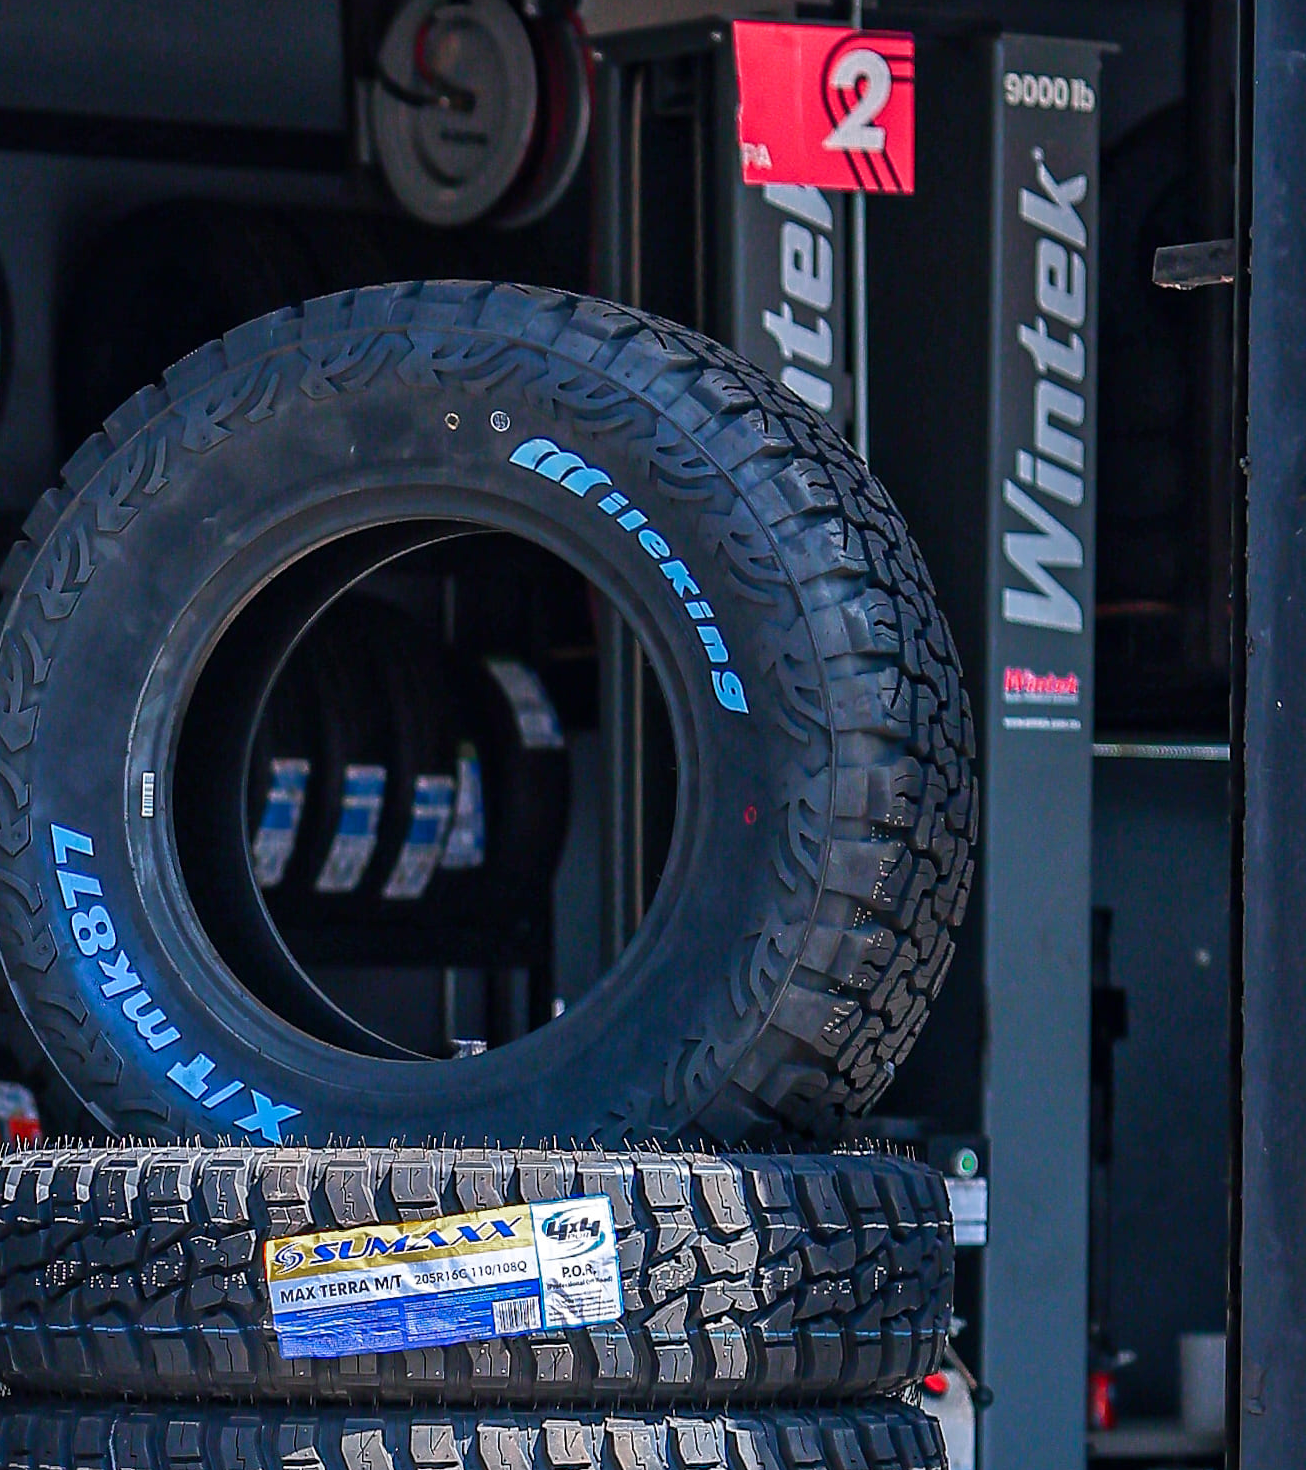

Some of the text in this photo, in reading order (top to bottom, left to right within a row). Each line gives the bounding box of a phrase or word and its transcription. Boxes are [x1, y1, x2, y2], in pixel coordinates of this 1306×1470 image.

[823, 48, 892, 152] 2
[1003, 72, 1096, 113] 9000 lb
[1002, 160, 1090, 634] Wintek
[310, 1216, 522, 1266] SUMAXX
[546, 1217, 601, 1241] 4x4
[280, 1260, 528, 1305] MAX TERRA M/T 205R16C 110/108Q
[561, 1263, 597, 1279] P.O.R.
